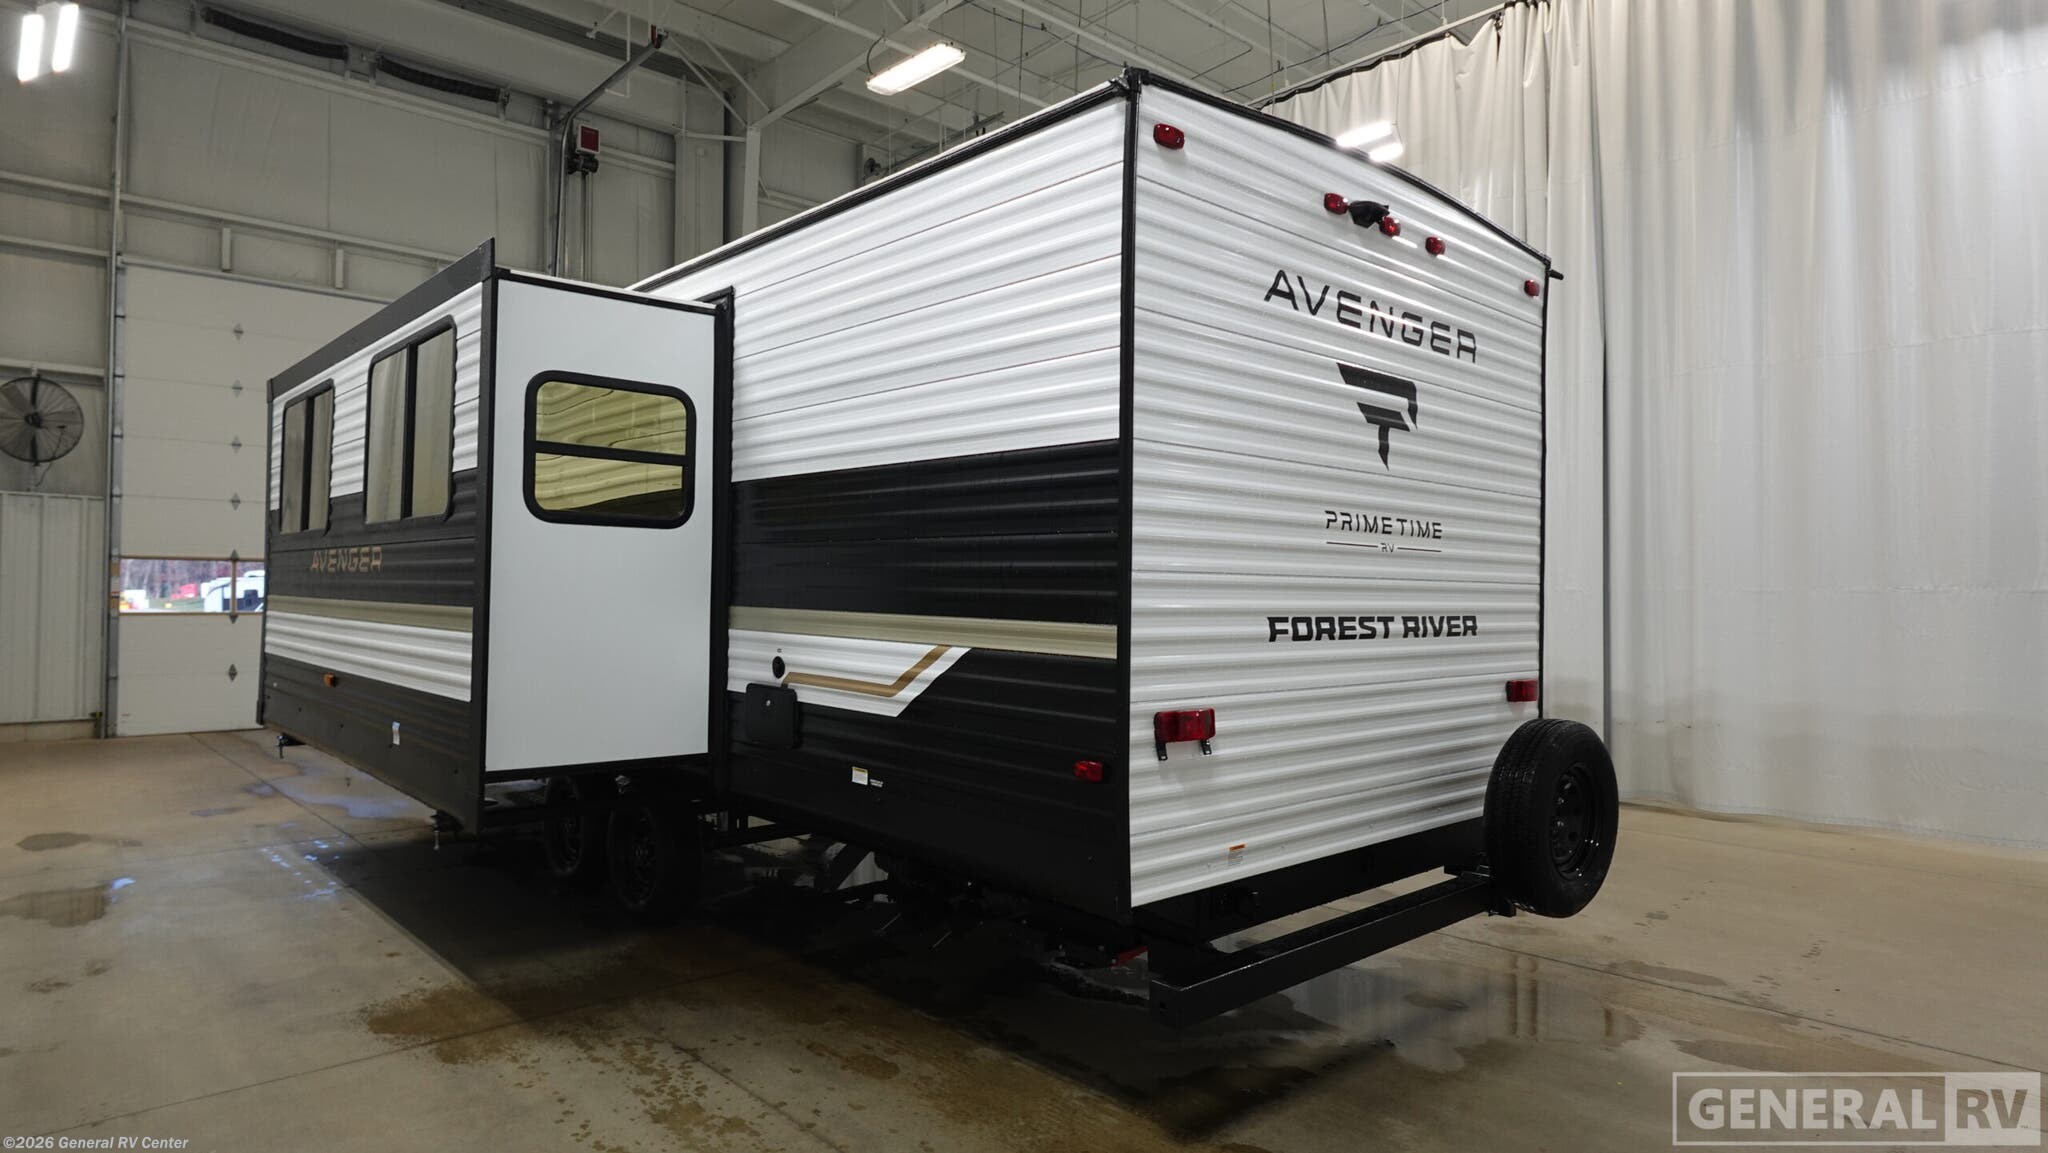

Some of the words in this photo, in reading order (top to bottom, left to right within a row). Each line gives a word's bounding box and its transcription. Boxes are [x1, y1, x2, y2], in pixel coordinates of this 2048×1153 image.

[1264, 269, 1477, 364] AVENGER
[1324, 510, 1443, 540] PRIMETIME
[310, 545, 384, 573] AVENGER
[1380, 542, 1395, 553] RV
[1266, 616, 1395, 642] FOREST
[1401, 615, 1478, 639] RIVER
